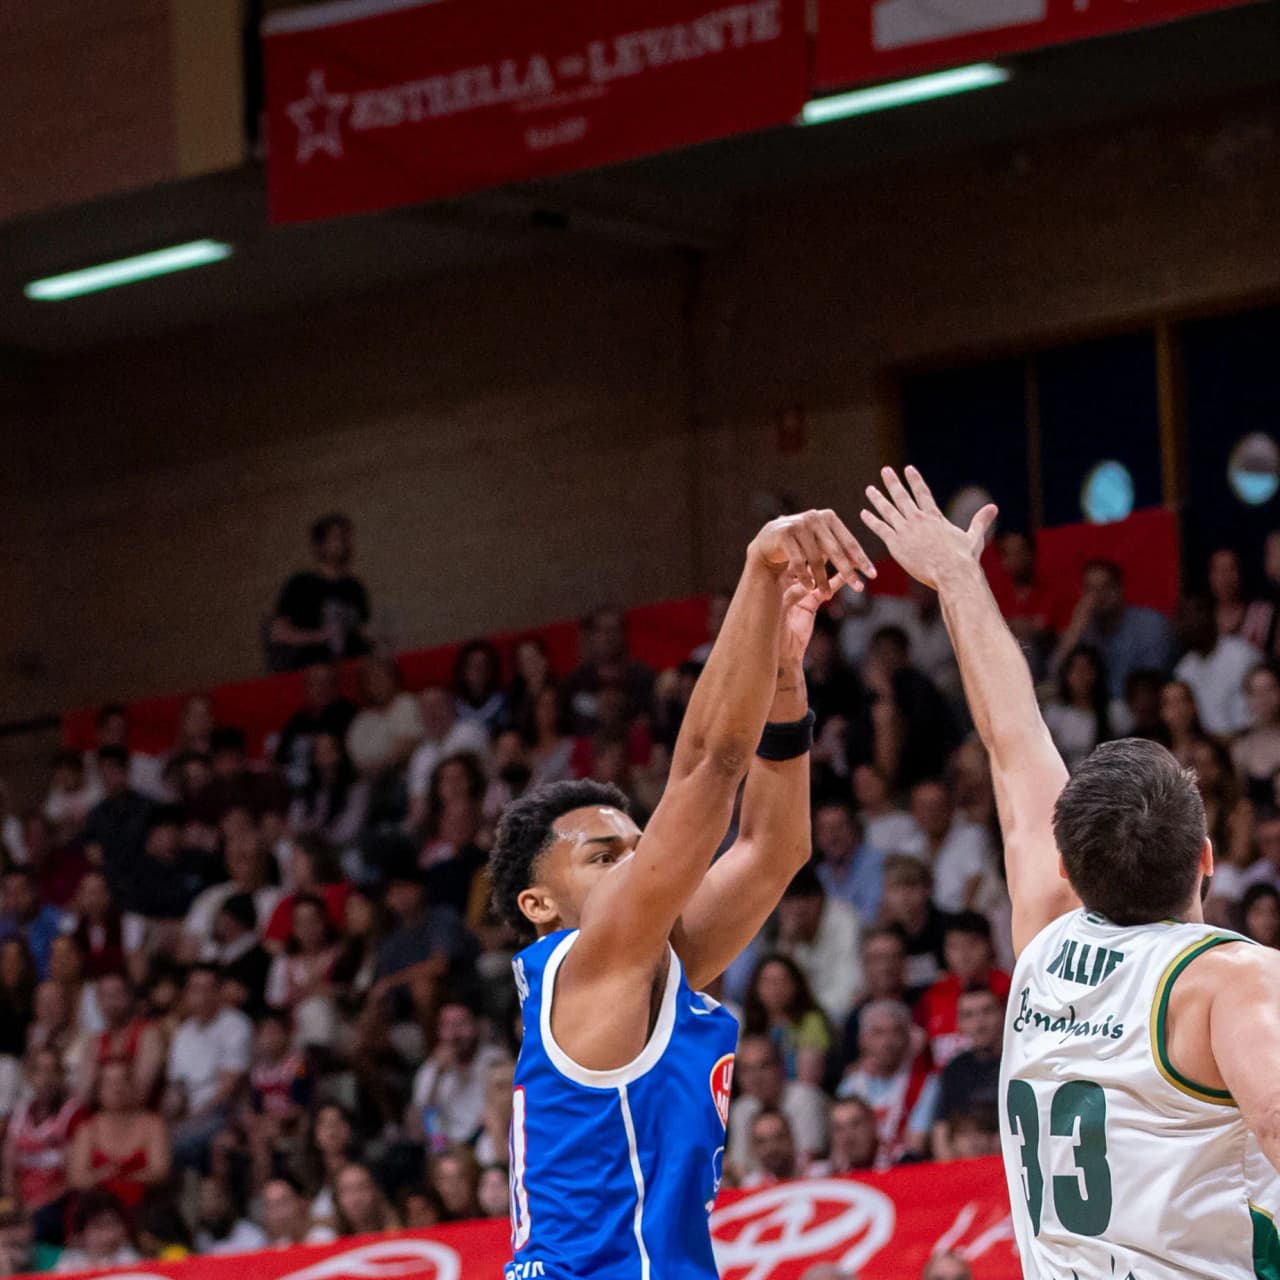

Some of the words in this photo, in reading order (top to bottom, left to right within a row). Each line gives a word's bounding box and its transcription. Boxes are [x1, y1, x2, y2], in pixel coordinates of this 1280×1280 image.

[350, 55, 553, 130] ESTRELLA
[587, 1, 782, 82] LEVANTE
[1007, 1079, 1113, 1237] 33
